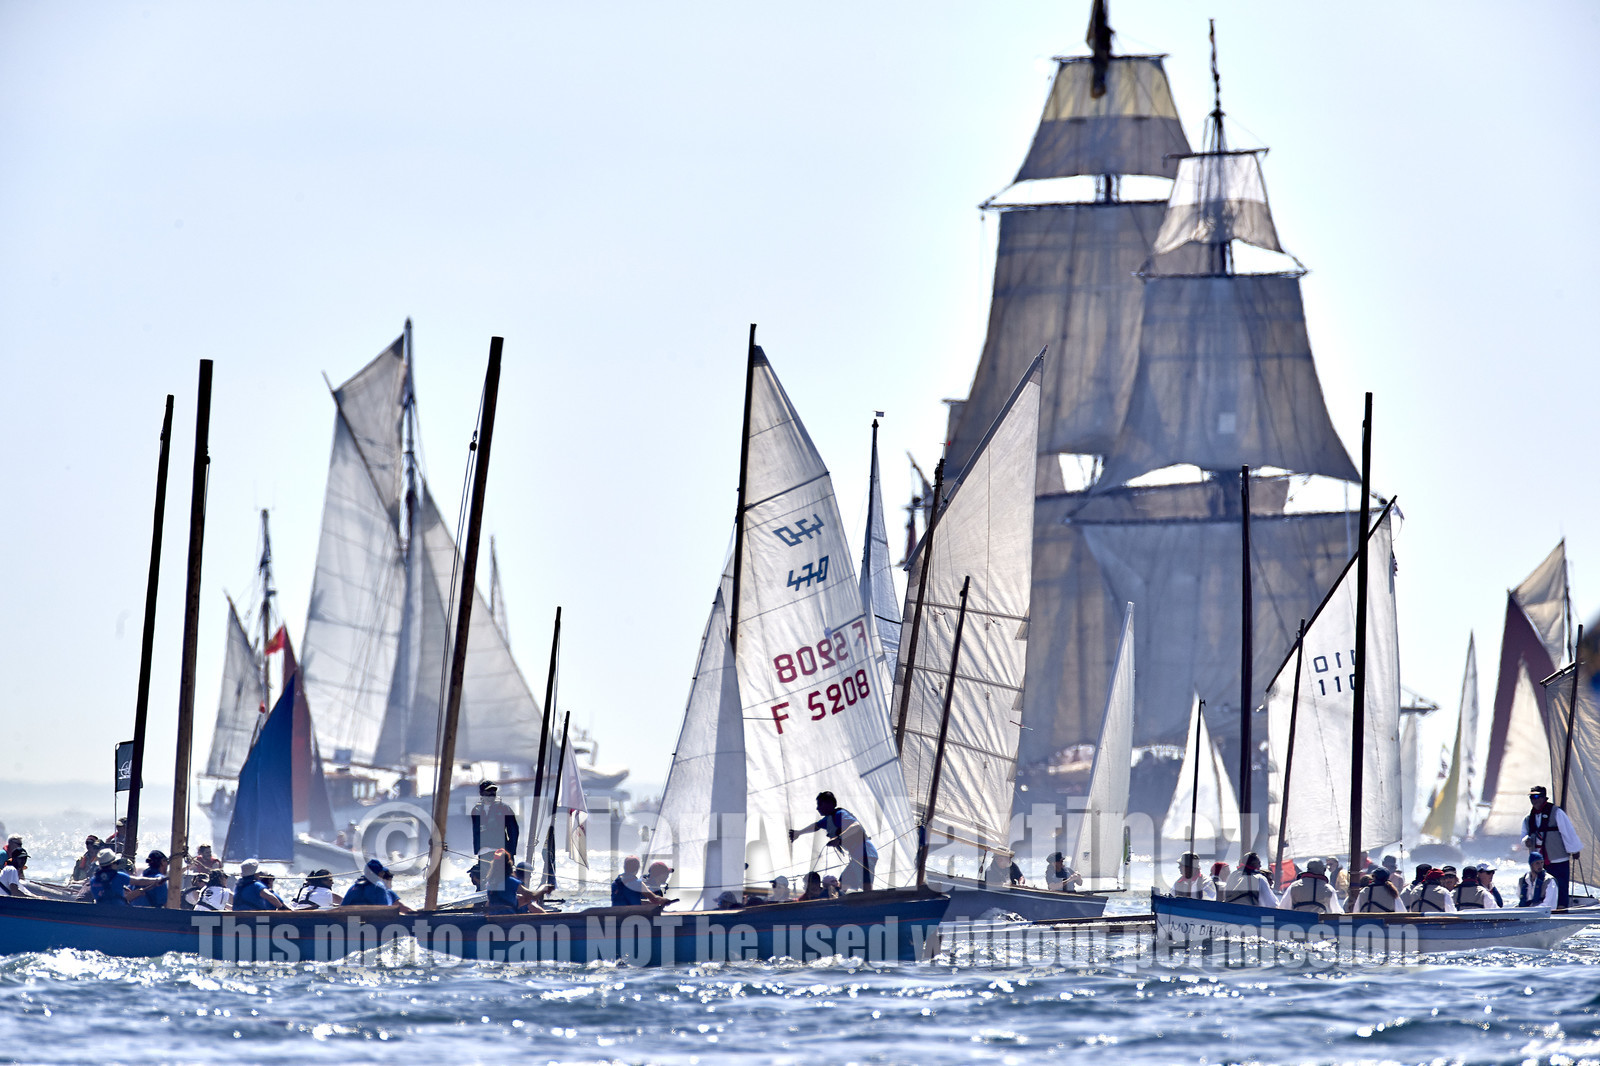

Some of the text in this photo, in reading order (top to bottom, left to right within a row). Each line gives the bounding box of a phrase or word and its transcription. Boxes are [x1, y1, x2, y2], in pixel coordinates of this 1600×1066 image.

[787, 555, 830, 592] 470
[771, 669, 871, 735] F 5208
